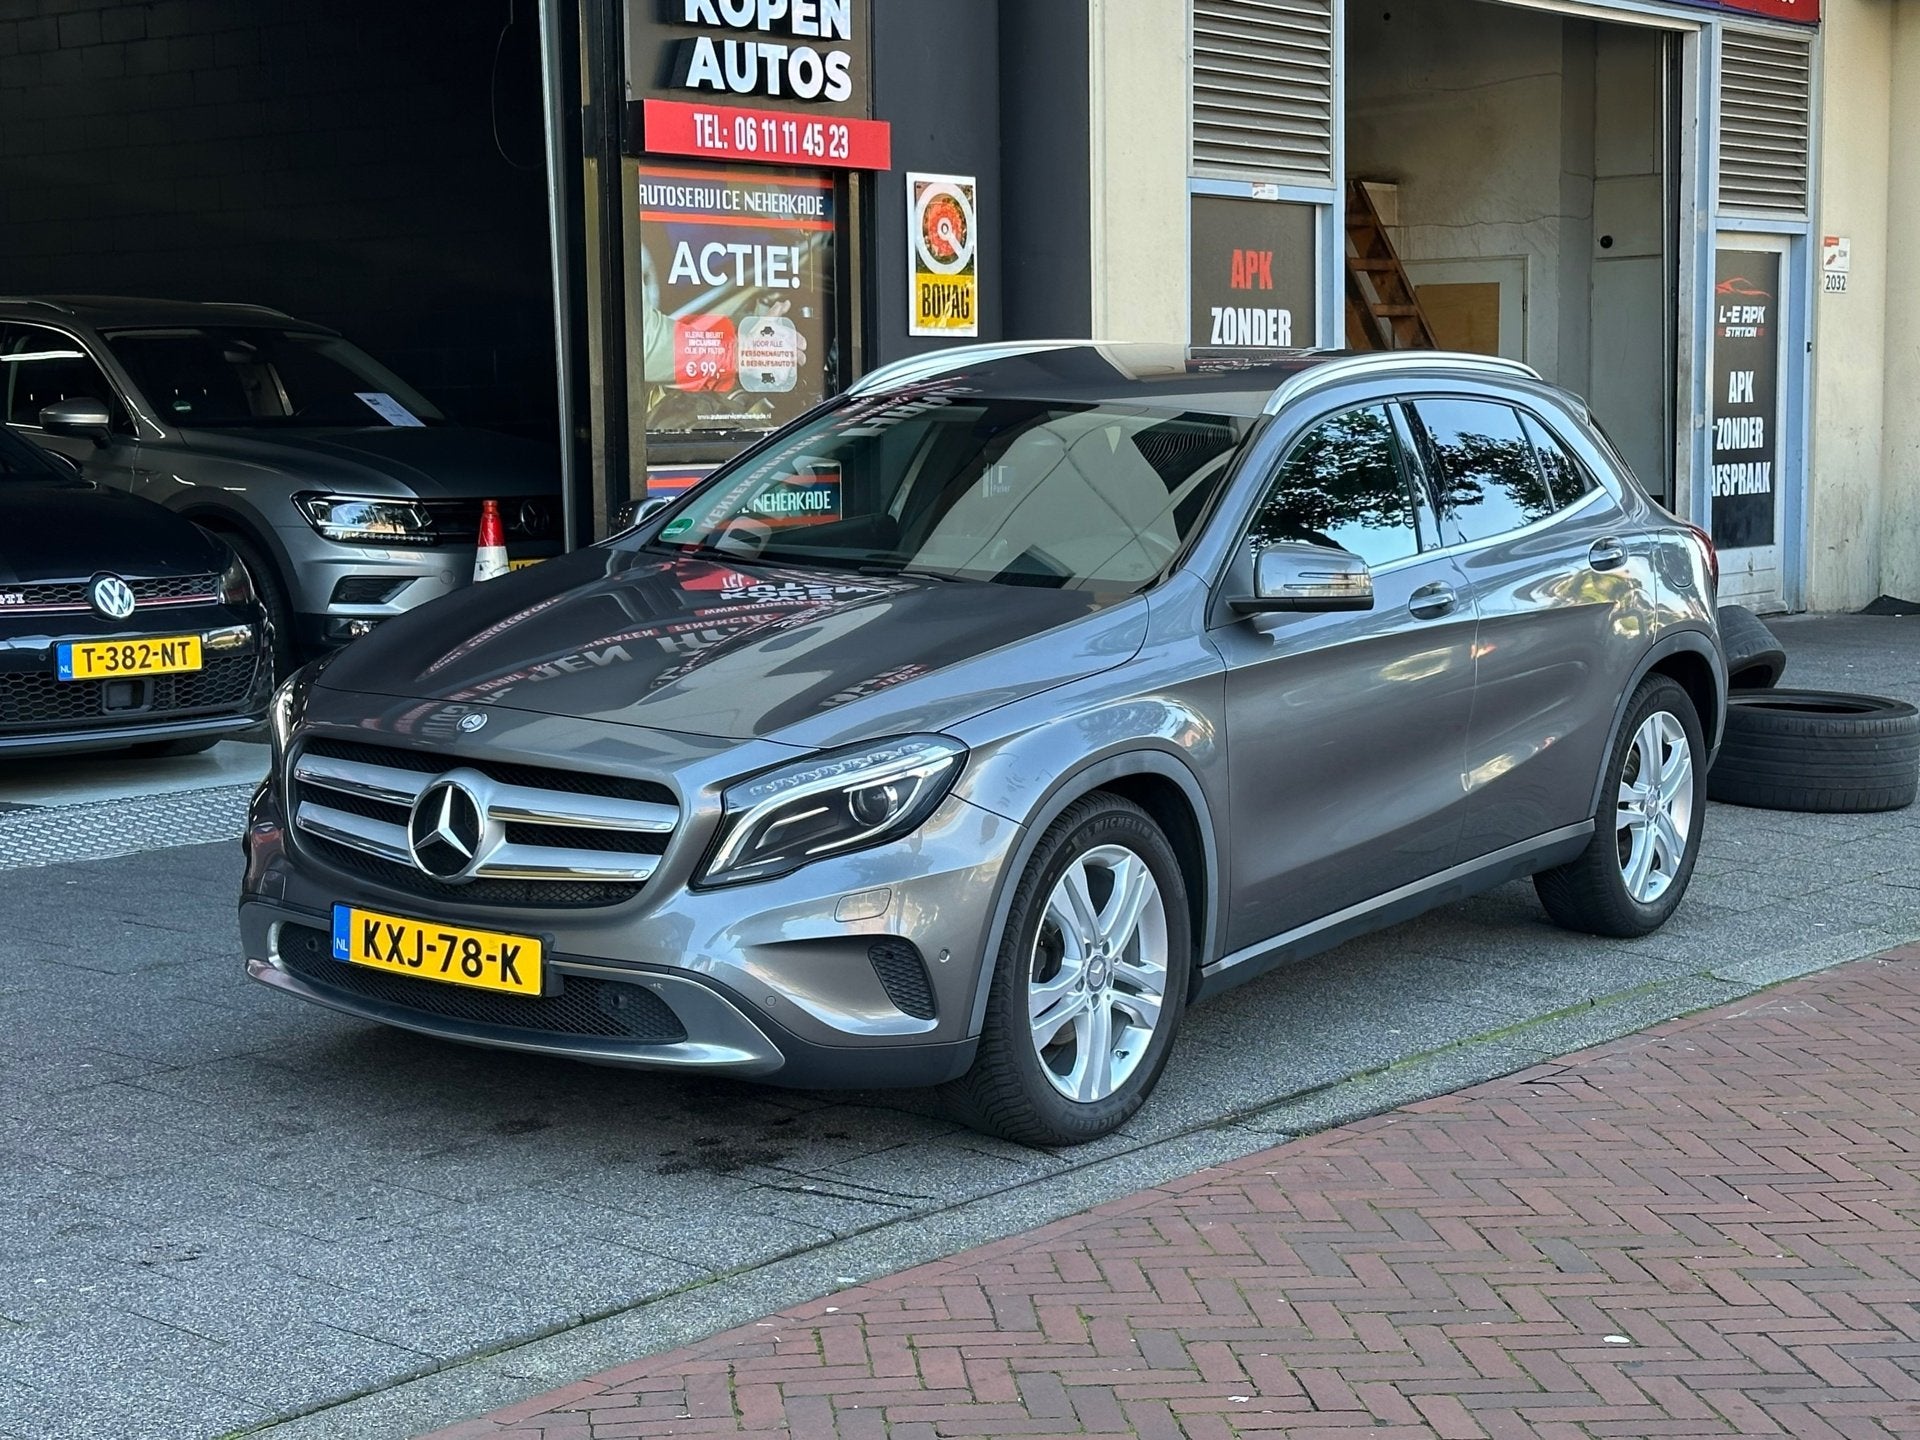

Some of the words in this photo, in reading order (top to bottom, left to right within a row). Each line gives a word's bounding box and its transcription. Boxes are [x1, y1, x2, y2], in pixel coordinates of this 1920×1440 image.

[685, 36, 852, 102] AUTOS
[693, 112, 728, 149] TEL:
[735, 116, 757, 152] 06
[761, 119, 777, 153] 11
[782, 121, 797, 155] 11
[802, 122, 824, 157] 45
[828, 124, 849, 159] 23
[639, 183, 740, 210] AUTOSERVICE
[744, 191, 825, 216] NEHERKADE
[668, 241, 800, 289] ACTIE!
[1231, 248, 1273, 290] APK
[1826, 274, 1846, 291] 2032
[922, 284, 969, 319] BOVAG
[1742, 305, 1766, 324] APK
[1211, 307, 1291, 346] ZONDER
[1725, 326, 1757, 338] STATION
[685, 361, 697, 377] €
[1728, 371, 1754, 403] APK
[1716, 416, 1764, 450] ZONDER
[754, 491, 831, 513] NEHERKADE
[60, 665, 71, 674] NL
[82, 642, 190, 672] T-382-NT
[336, 936, 348, 951] NL
[363, 919, 523, 985] KXJ-78-K
